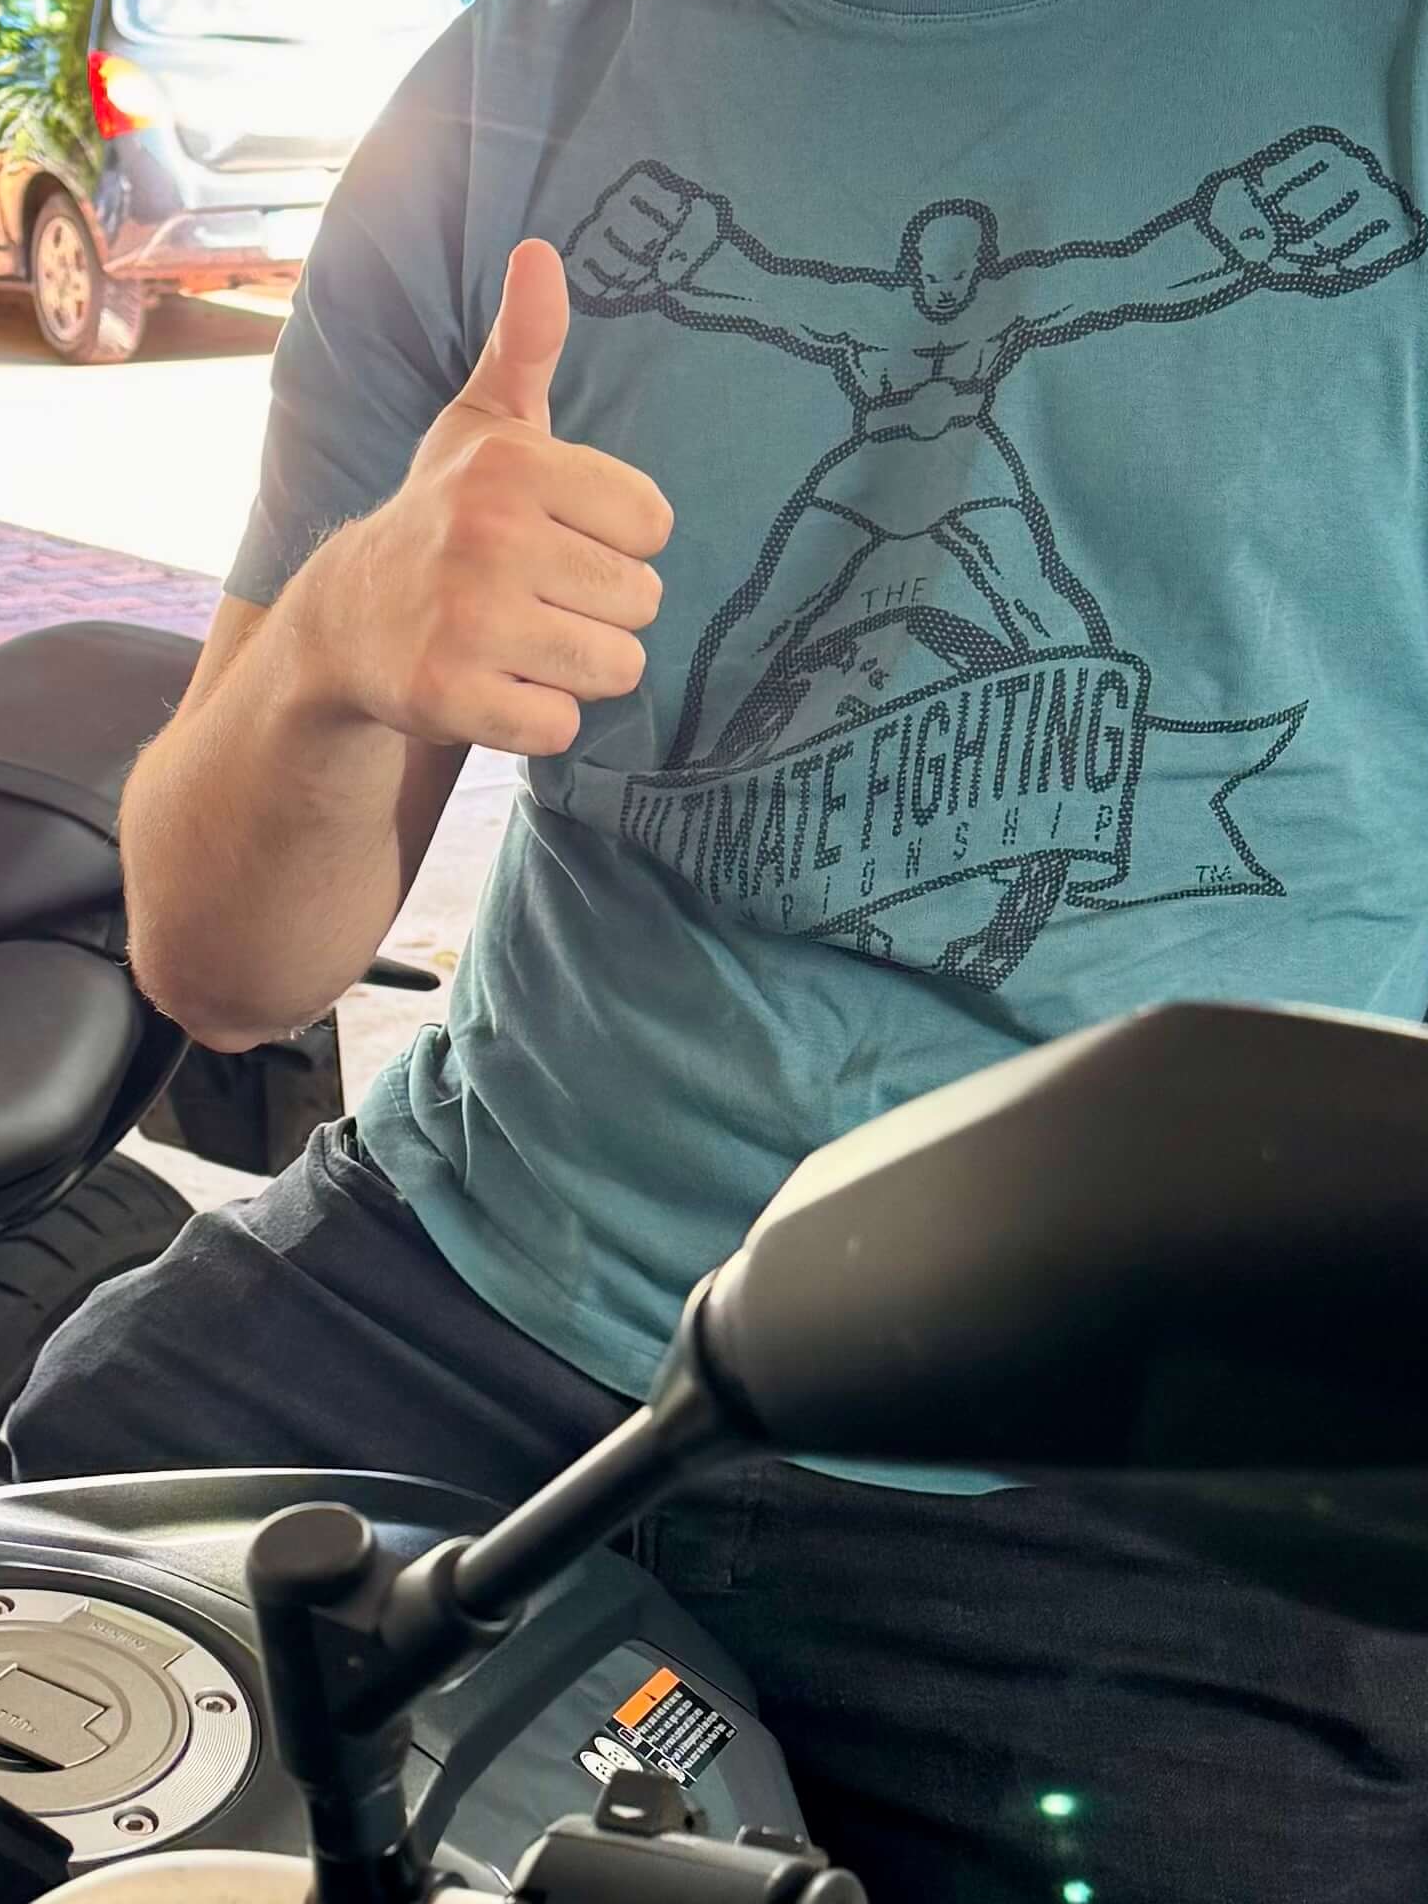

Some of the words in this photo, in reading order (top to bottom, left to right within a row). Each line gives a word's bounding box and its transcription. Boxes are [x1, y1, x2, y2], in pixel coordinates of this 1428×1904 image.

[860, 577, 928, 613] THE
[859, 667, 1131, 852] FIGHTING
[1195, 865, 1233, 884] TM
